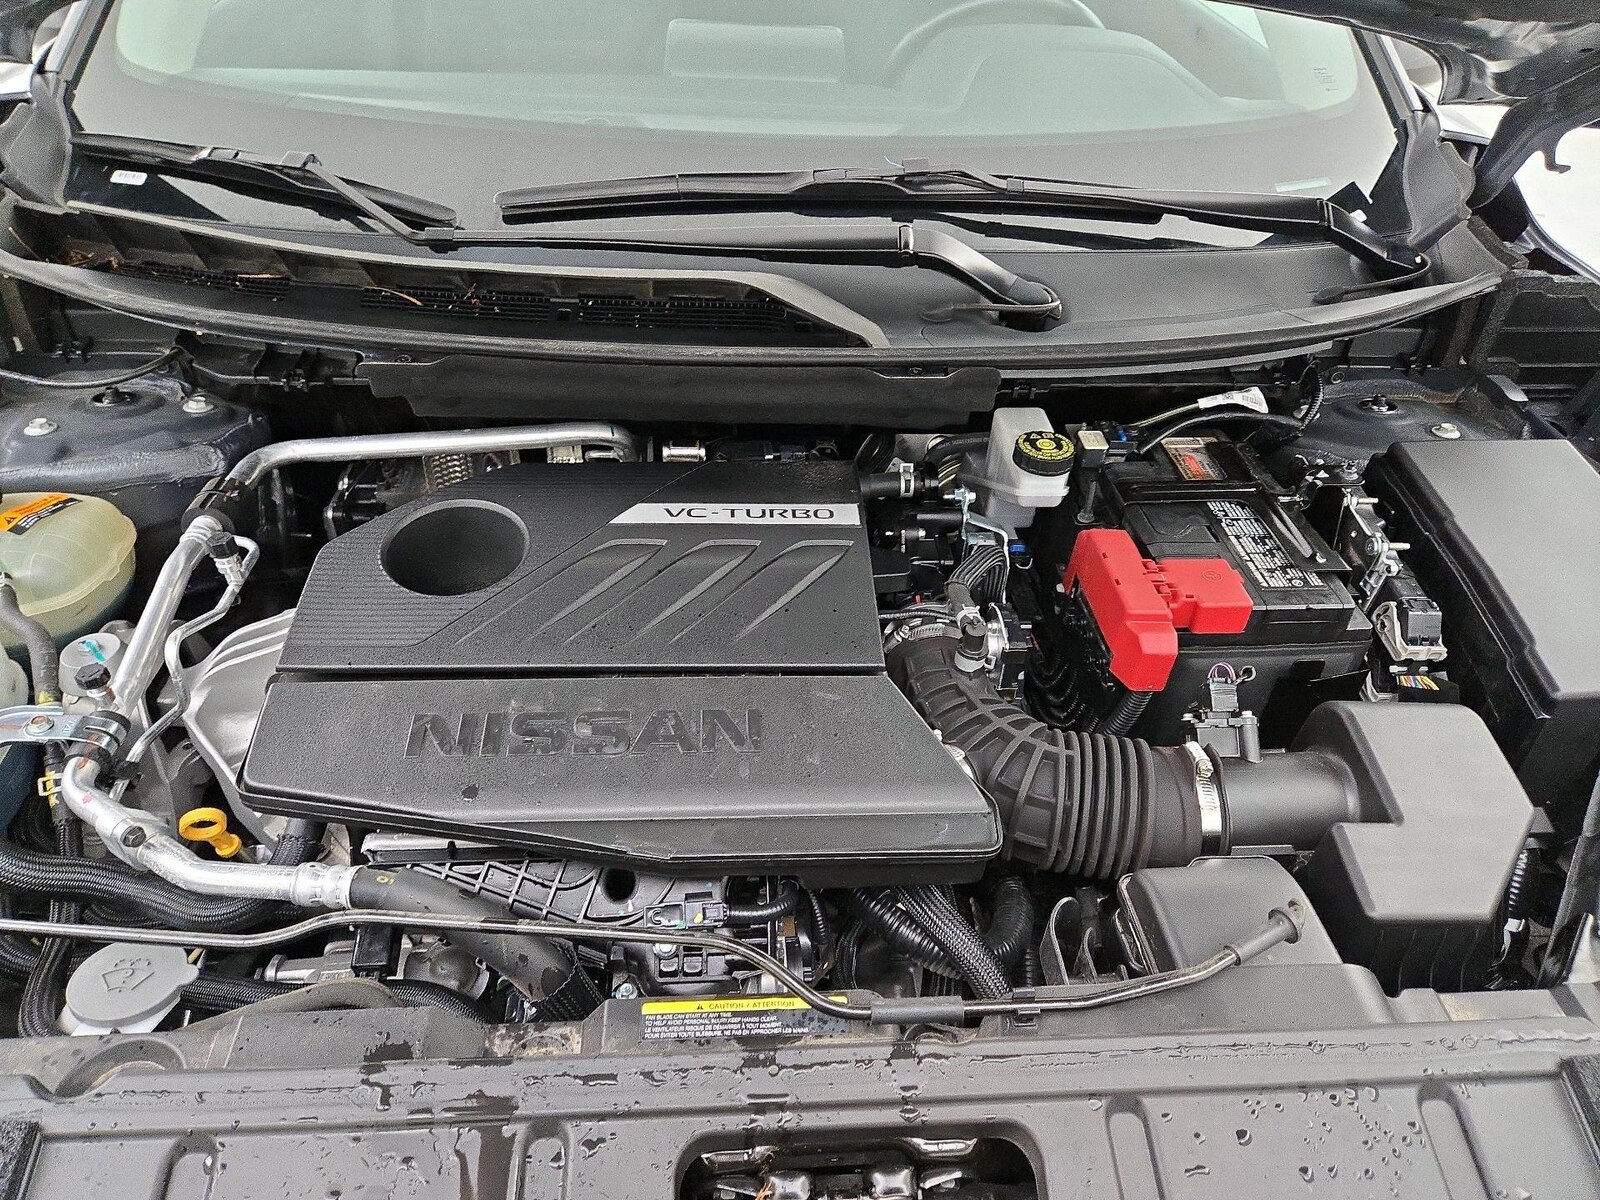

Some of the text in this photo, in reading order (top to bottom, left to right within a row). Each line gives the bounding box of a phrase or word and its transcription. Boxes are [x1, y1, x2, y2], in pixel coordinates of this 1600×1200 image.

[664, 508, 834, 519] VC-TURBO
[403, 708, 762, 757] NISSAN
[708, 1002, 744, 1010] CAUTION
[752, 1000, 795, 1008] ATTENTION
